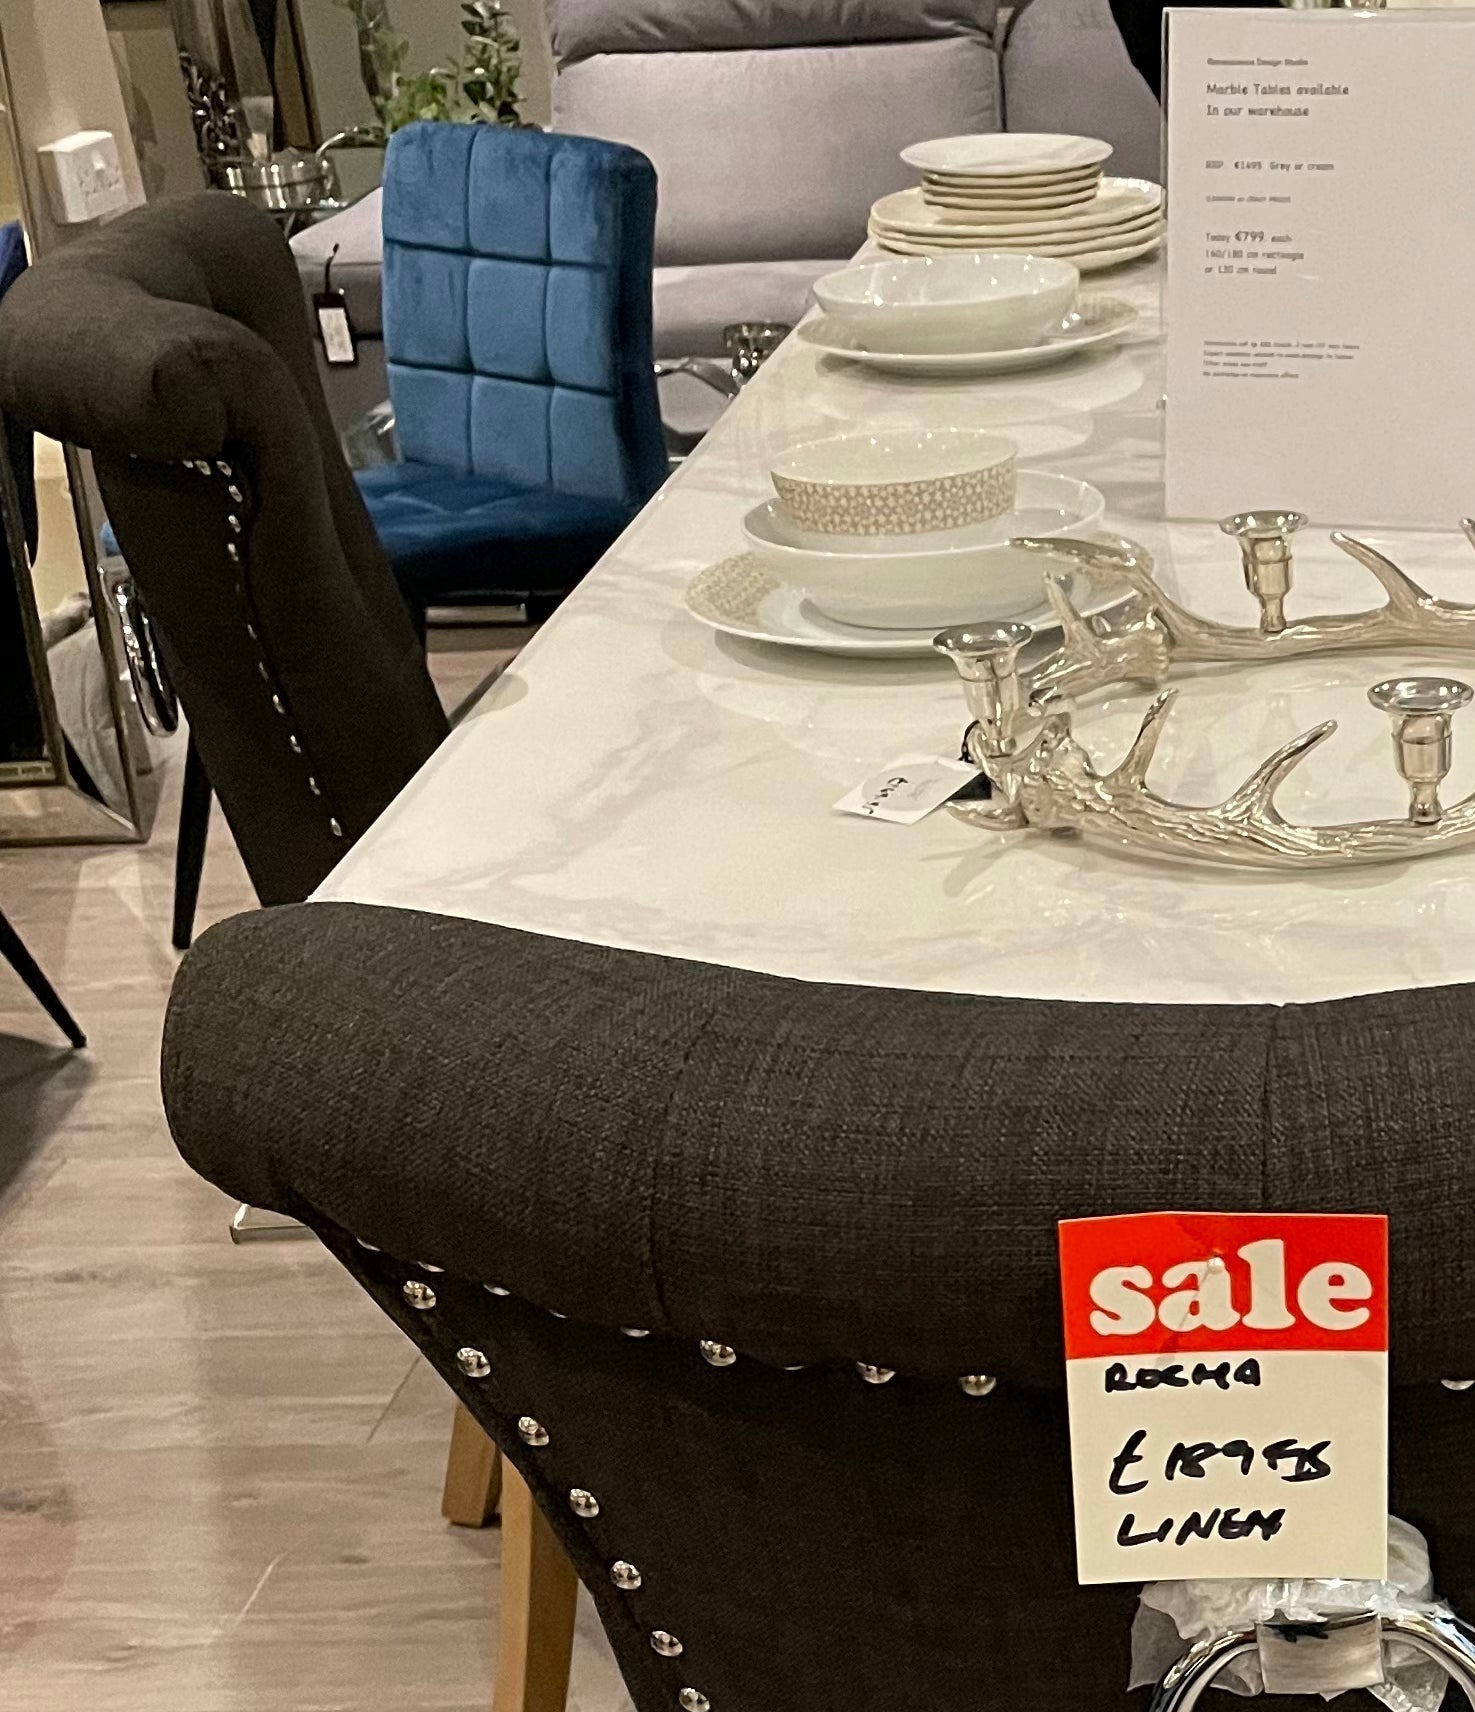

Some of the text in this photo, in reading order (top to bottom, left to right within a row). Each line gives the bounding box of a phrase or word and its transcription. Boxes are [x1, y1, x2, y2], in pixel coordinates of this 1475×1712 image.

[1206, 83, 1349, 95] Marble Tables available
[1088, 1238, 1373, 1336] sale
